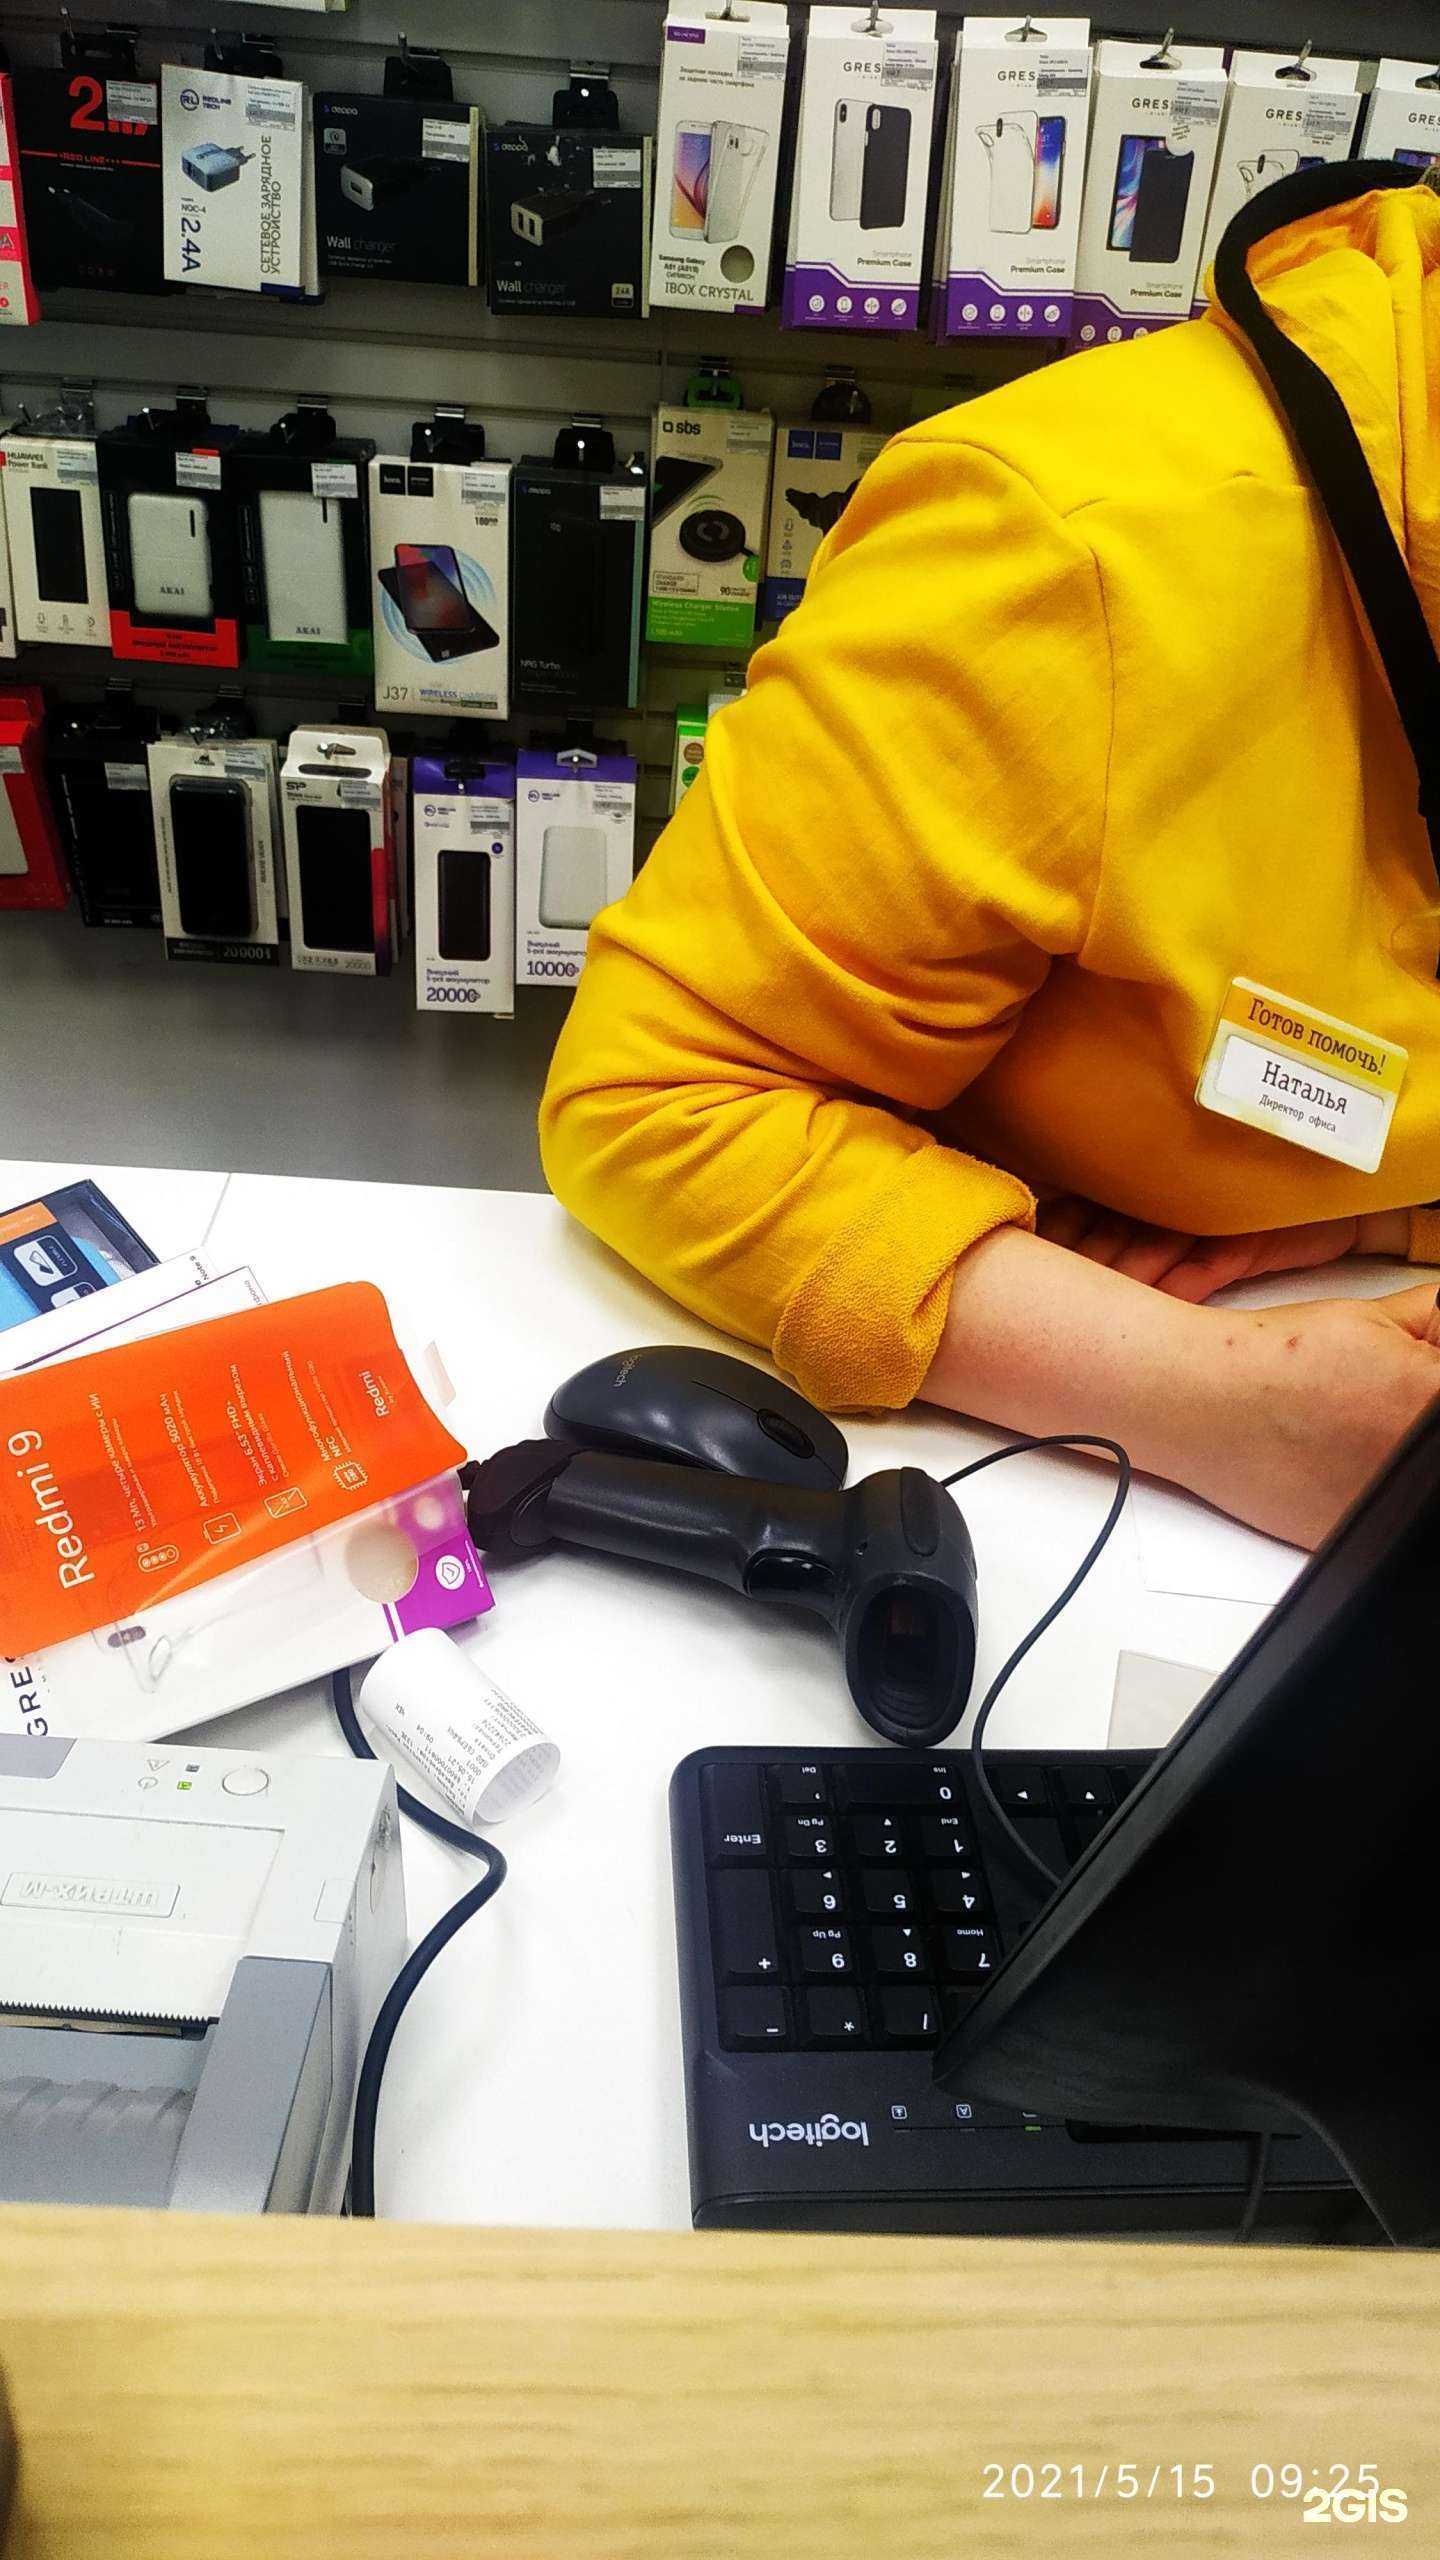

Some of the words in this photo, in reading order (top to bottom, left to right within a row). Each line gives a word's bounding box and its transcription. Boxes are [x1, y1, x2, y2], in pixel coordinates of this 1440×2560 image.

[260, 135, 273, 209] ЗАРЯДНОЕ
[270, 181, 282, 275] УСТРОЙСТВО
[260, 213, 272, 274] СЕТЕВОЕ
[326, 236, 351, 249] Wall
[857, 257, 889, 268] Premium
[892, 259, 912, 268] Case
[1010, 265, 1044, 275] Premium
[1046, 265, 1065, 274] Case
[496, 280, 522, 293] Wall
[699, 285, 754, 301] CRYSTAL
[1130, 289, 1160, 299] Premium
[1162, 290, 1182, 299] Case
[676, 421, 701, 436] sbs
[160, 586, 185, 596] AKAI
[296, 626, 321, 636] AKAI
[383, 686, 408, 701] J37
[527, 961, 576, 977] 10000
[426, 988, 477, 1003] 20000
[1248, 998, 1305, 1040] Готов
[1307, 1030, 1387, 1076] помочь!
[1261, 1060, 1348, 1114] Наталья
[1258, 1094, 1304, 1120] Директор
[1308, 1112, 1336, 1133] офиса
[230, 1364, 248, 1408] вырезом
[89, 1393, 101, 1410] ИИ
[359, 1371, 390, 1417] Redmi
[160, 1393, 171, 1414] мАч
[282, 1351, 331, 1461] Многофункциональный
[226, 1400, 241, 1430] FHD+
[164, 1416, 177, 1443] 5020
[7, 1431, 43, 1456] 9
[98, 1419, 116, 1459] камеры
[243, 1409, 276, 1474] каплевидным
[326, 1436, 342, 1458] NFC
[112, 1460, 130, 1497] четыре
[178, 1443, 209, 1507] Аккумулятор
[249, 1456, 267, 1487] Экран
[18, 1459, 95, 1589] Redmi
[134, 1519, 146, 1533] 13
[5, 1656, 48, 1736] GRE
[466, 1760, 482, 1776] 0001
[802, 1766, 816, 1774] Del
[933, 1766, 946, 1774] Ins
[939, 1786, 951, 1799] 0
[811, 1818, 824, 1826] Pg
[941, 1817, 958, 1825] End
[724, 1834, 761, 1844] Enter
[814, 1839, 827, 1853] 3
[884, 1840, 896, 1853] 2
[953, 1839, 964, 1853] 1
[823, 1895, 836, 1909] 6
[894, 1895, 906, 1909] 5
[962, 1895, 975, 1909] 4
[813, 1930, 827, 1938] Up
[957, 1929, 984, 1937] Home
[832, 1953, 845, 1968] 9
[903, 1952, 917, 1967] 8
[979, 1953, 990, 1967] 7
[749, 2113, 869, 2147] logitech
